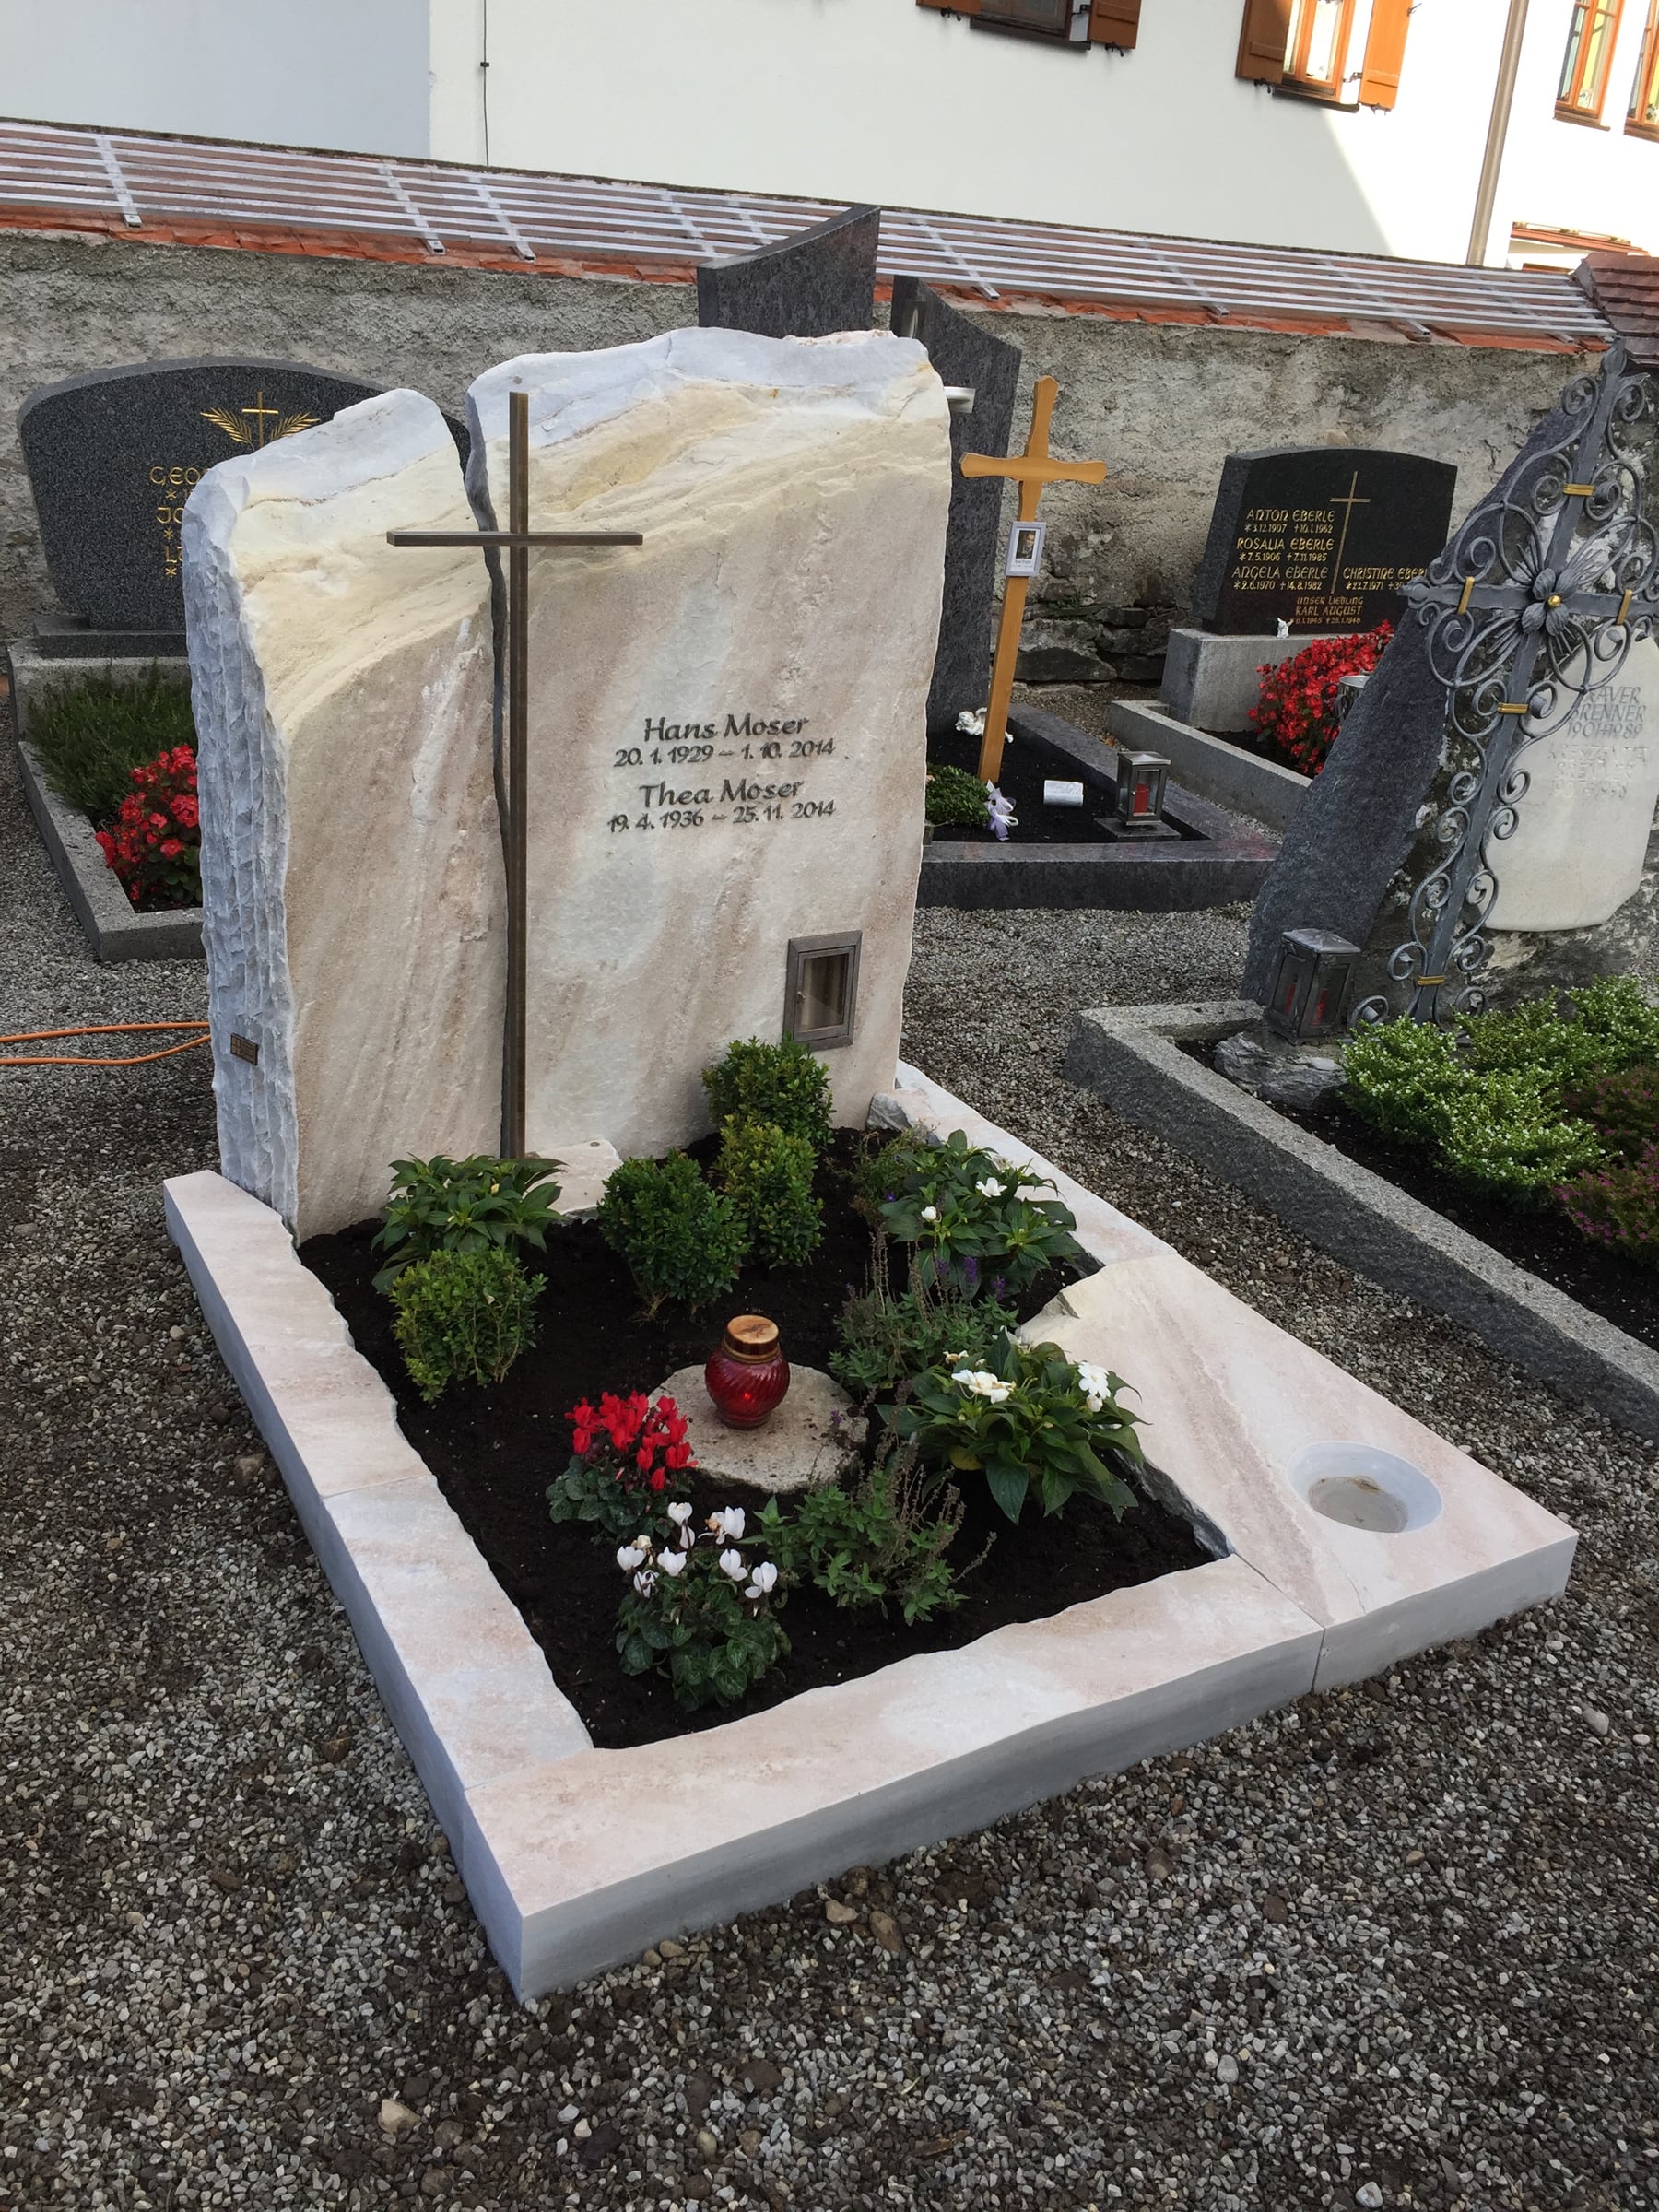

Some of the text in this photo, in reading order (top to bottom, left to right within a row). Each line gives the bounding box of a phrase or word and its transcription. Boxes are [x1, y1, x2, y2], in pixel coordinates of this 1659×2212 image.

[1246, 509, 1335, 523] ANTON EBERLE
[1236, 537, 1335, 551] ROSALIA EBERLE
[1231, 565, 1329, 580] ANGELA EBERLE
[1343, 567, 1428, 580] CHRISTINE EBERL
[1296, 595, 1364, 606] UNSER LIEBLING
[1295, 605, 1364, 617] KARL AUGUST
[644, 713, 809, 742] Hans Moser
[640, 779, 805, 808] Thea Moser
